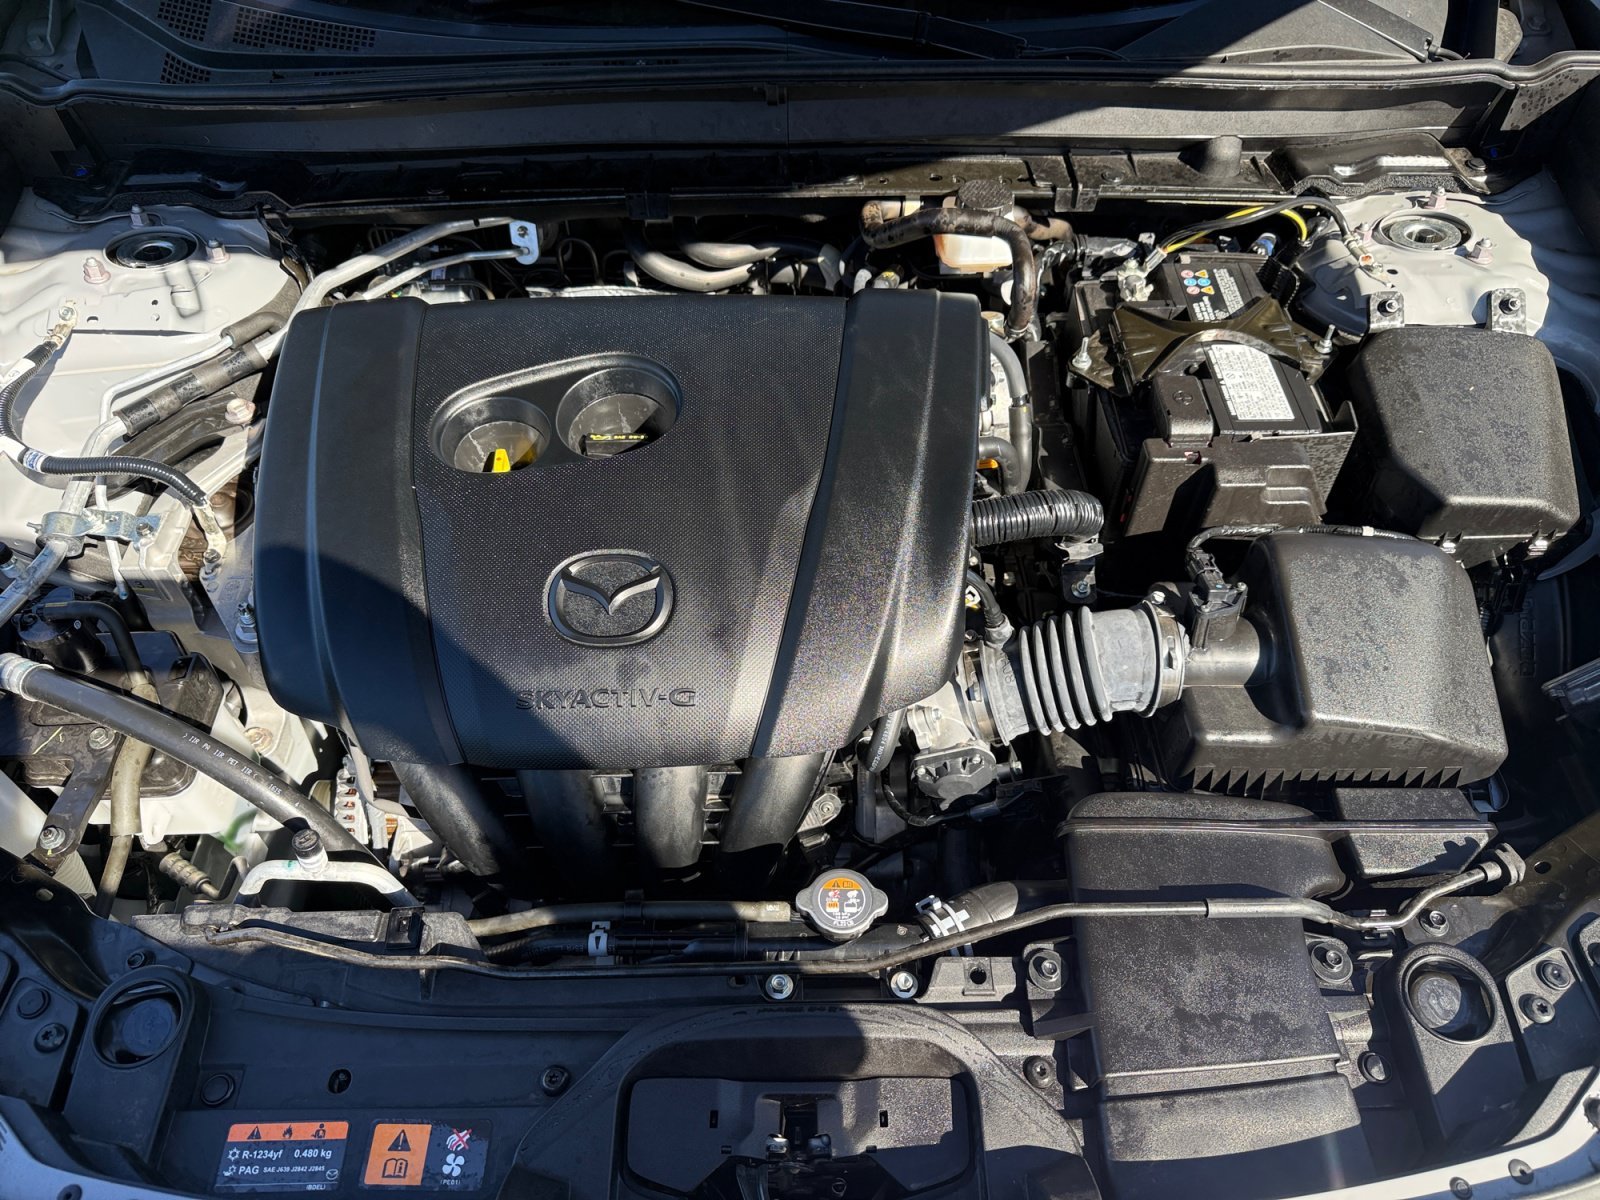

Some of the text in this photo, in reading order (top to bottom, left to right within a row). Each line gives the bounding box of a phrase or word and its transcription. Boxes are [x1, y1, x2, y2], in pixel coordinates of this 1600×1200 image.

[515, 687, 697, 710] SKYACTIV-G
[242, 1148, 332, 1160] R-1234yf 0.480 kg
[238, 1165, 260, 1175] PAG
